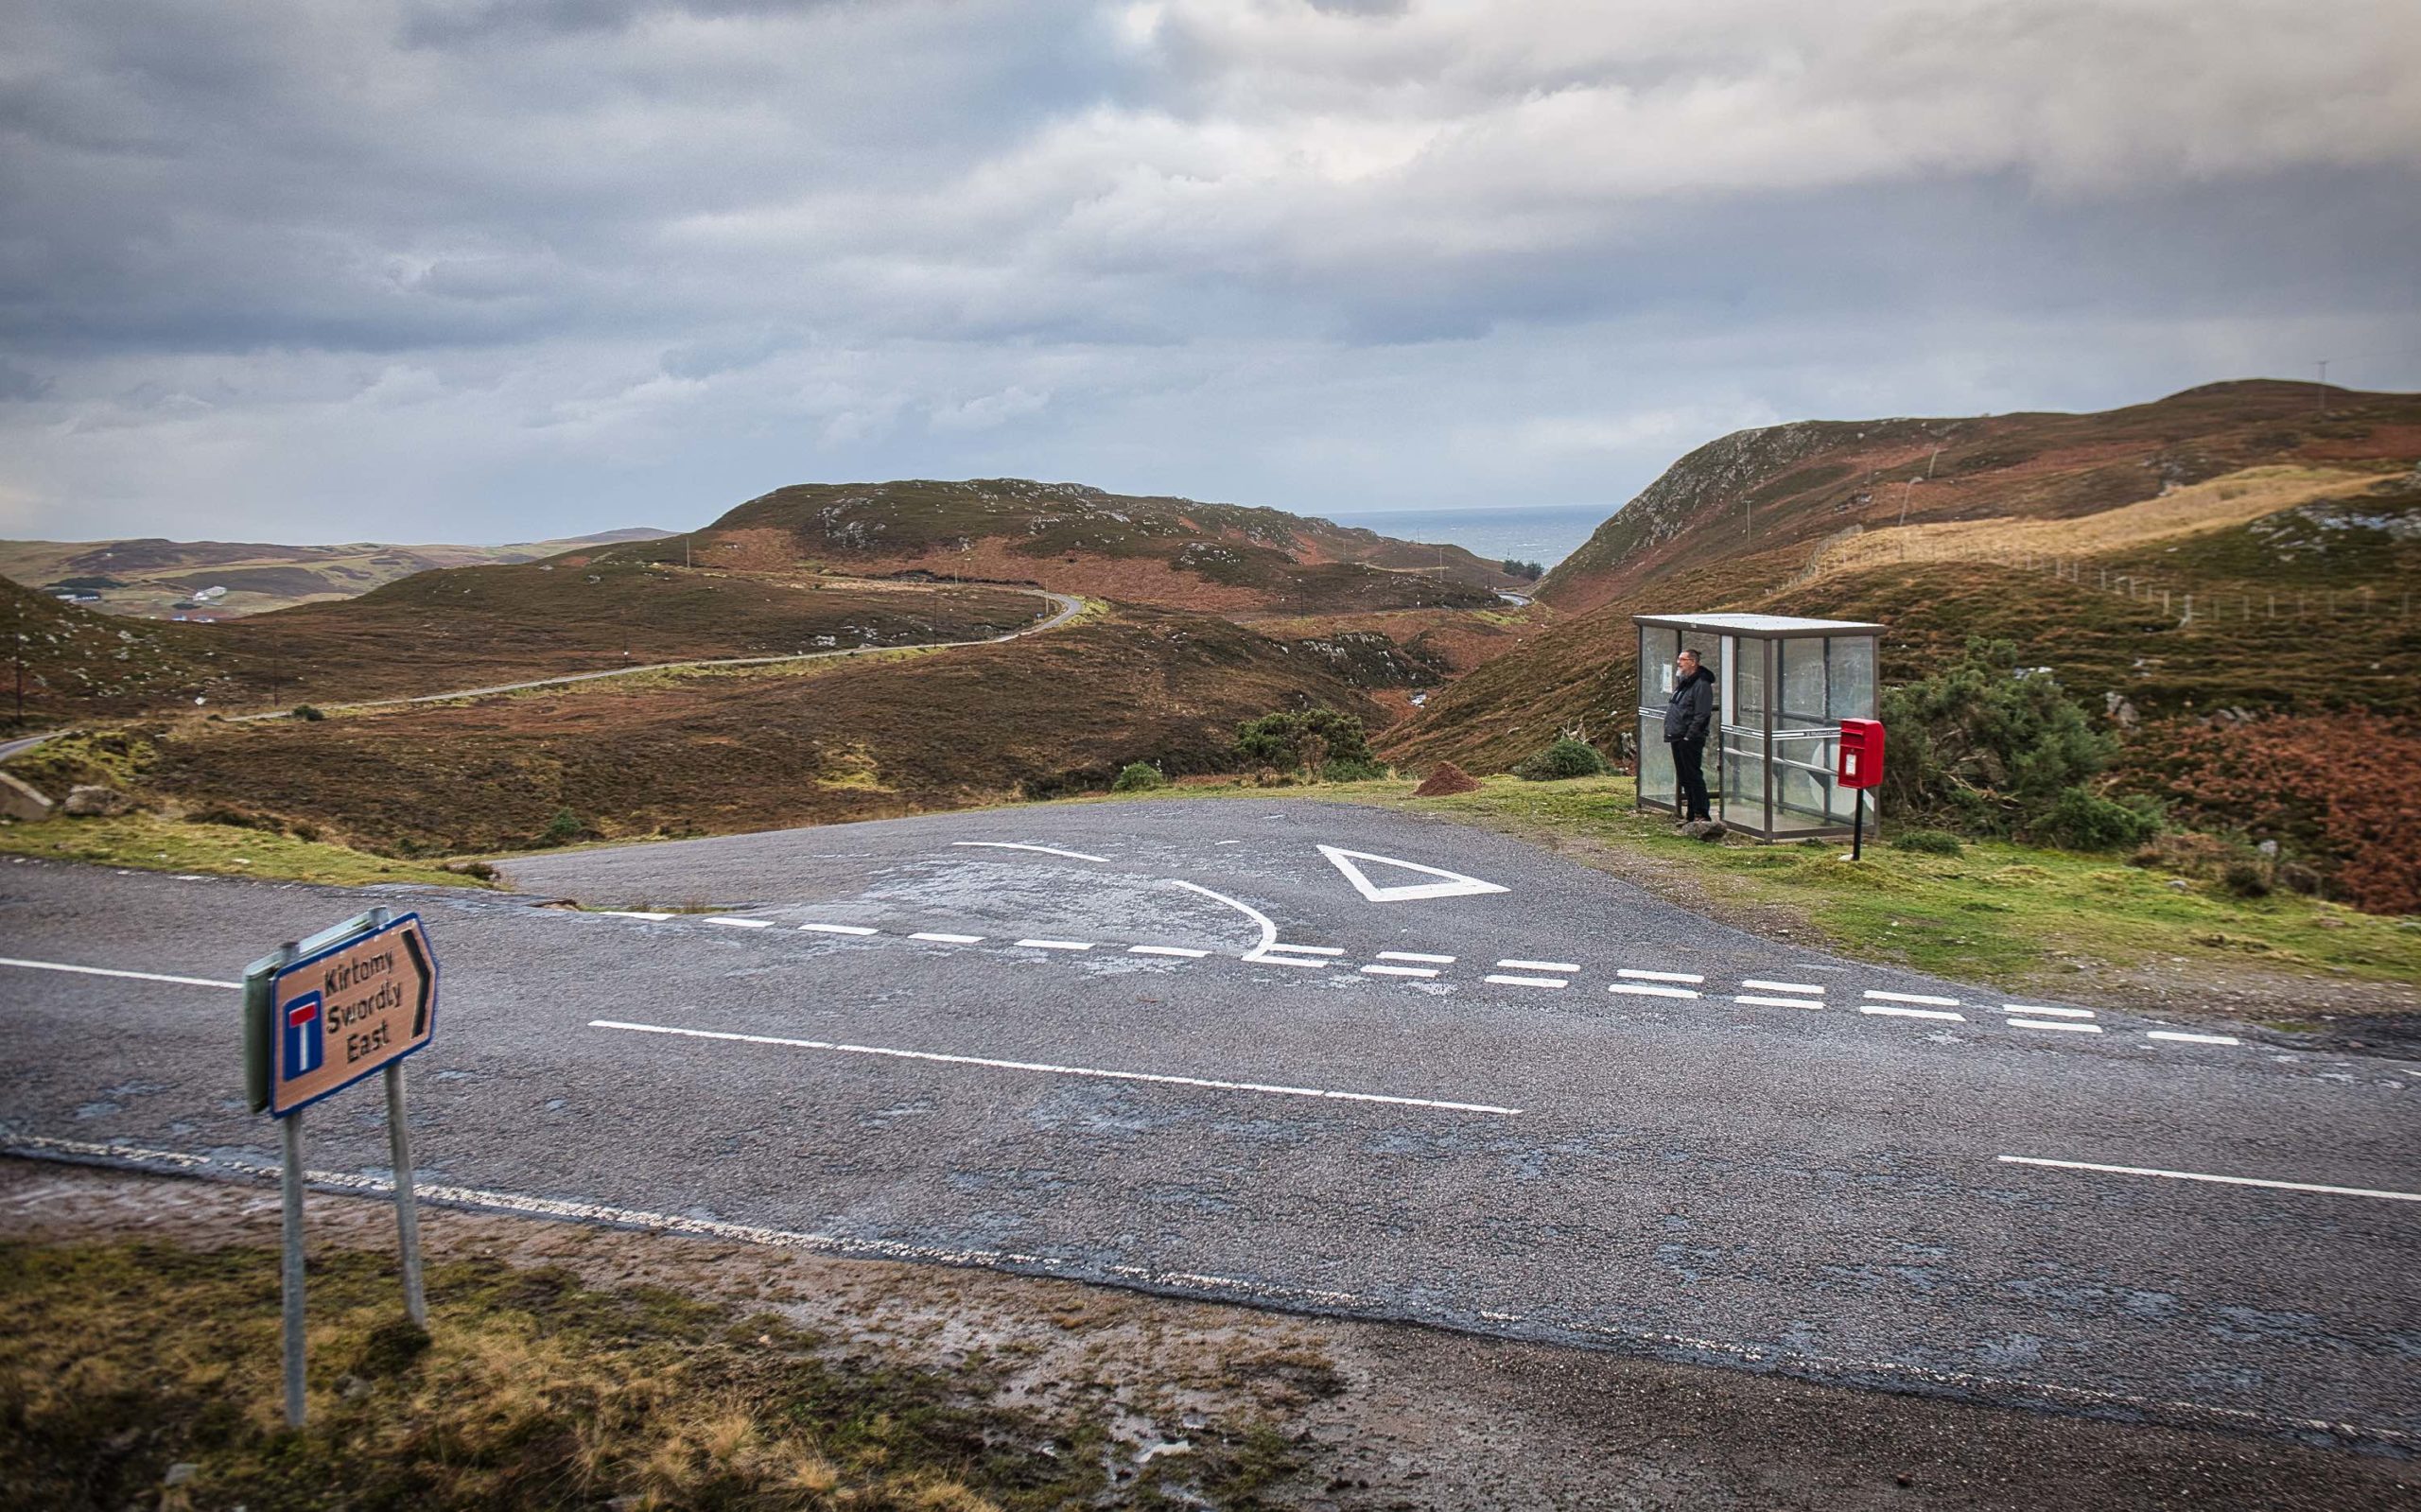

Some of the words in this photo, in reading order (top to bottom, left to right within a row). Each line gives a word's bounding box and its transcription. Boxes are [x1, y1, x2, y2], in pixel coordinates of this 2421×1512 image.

[325, 950, 393, 997] Kirtomy
[327, 980, 402, 1034] Swordly
[347, 1020, 391, 1064] East
